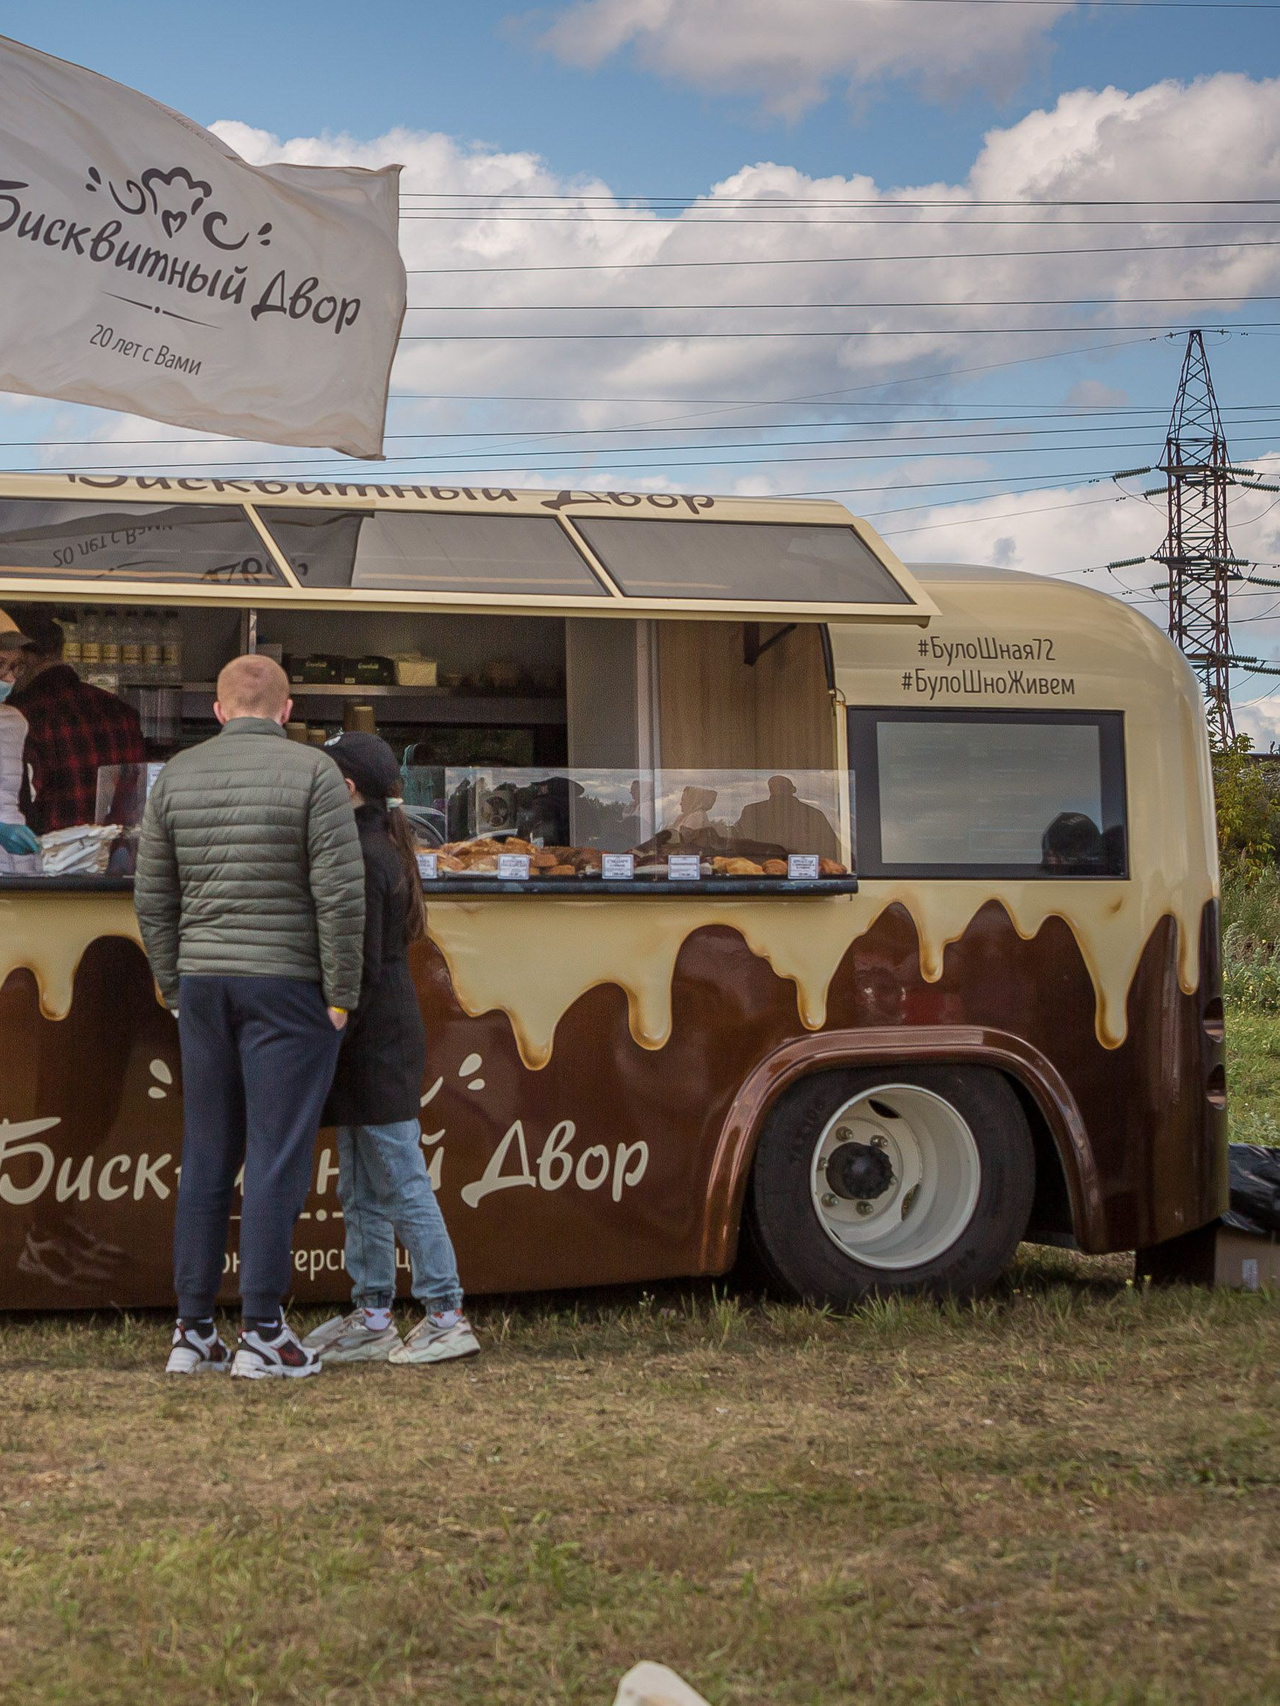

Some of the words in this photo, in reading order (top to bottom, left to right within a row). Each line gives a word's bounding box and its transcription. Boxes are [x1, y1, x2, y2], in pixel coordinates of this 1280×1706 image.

[251, 269, 361, 334] Двор
[89, 323, 114, 348] 20
[111, 338, 143, 358] лет
[142, 347, 154, 362] с
[154, 345, 202, 375] Вами
[917, 635, 1056, 667] #БулоШная72
[901, 668, 1076, 701] #БулоШноЖивем
[460, 1119, 650, 1209] Двор
